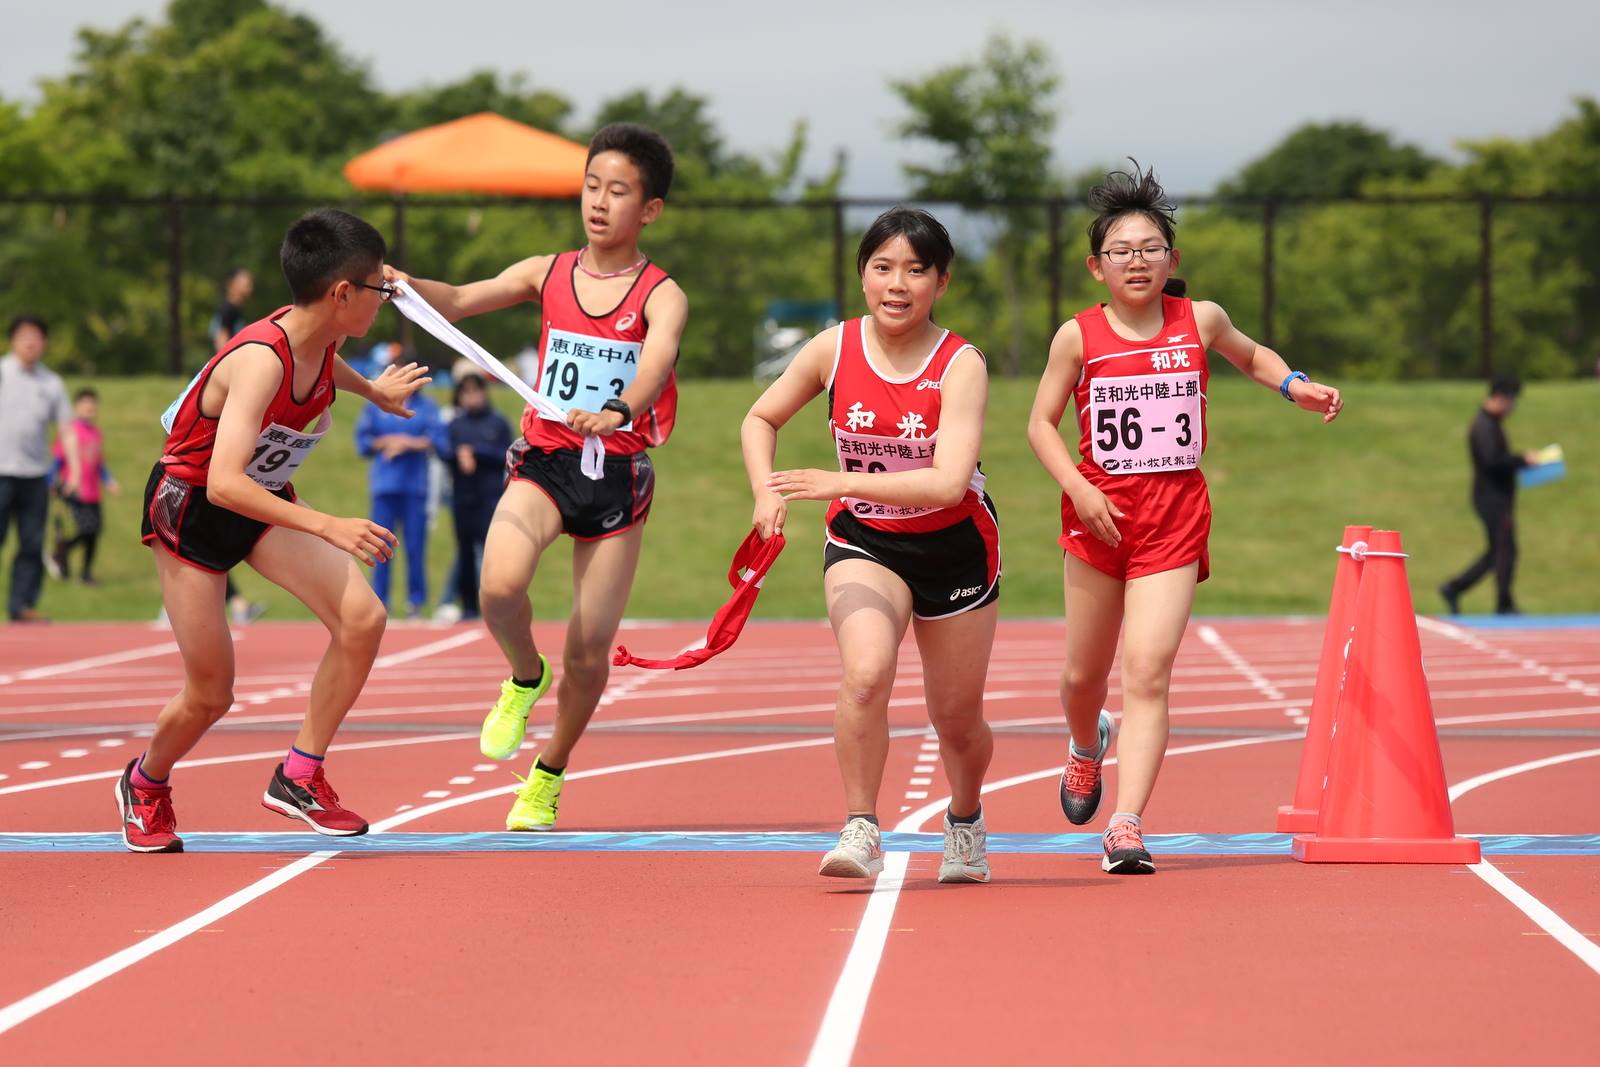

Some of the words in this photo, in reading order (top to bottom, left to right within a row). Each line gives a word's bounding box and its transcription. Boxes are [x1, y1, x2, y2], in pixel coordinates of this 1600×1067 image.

[550, 337, 636, 364] 恵庭中A
[1151, 350, 1191, 371] 和光
[1093, 380, 1198, 403] 苫和光中陸上部
[263, 428, 320, 449] 恵庭
